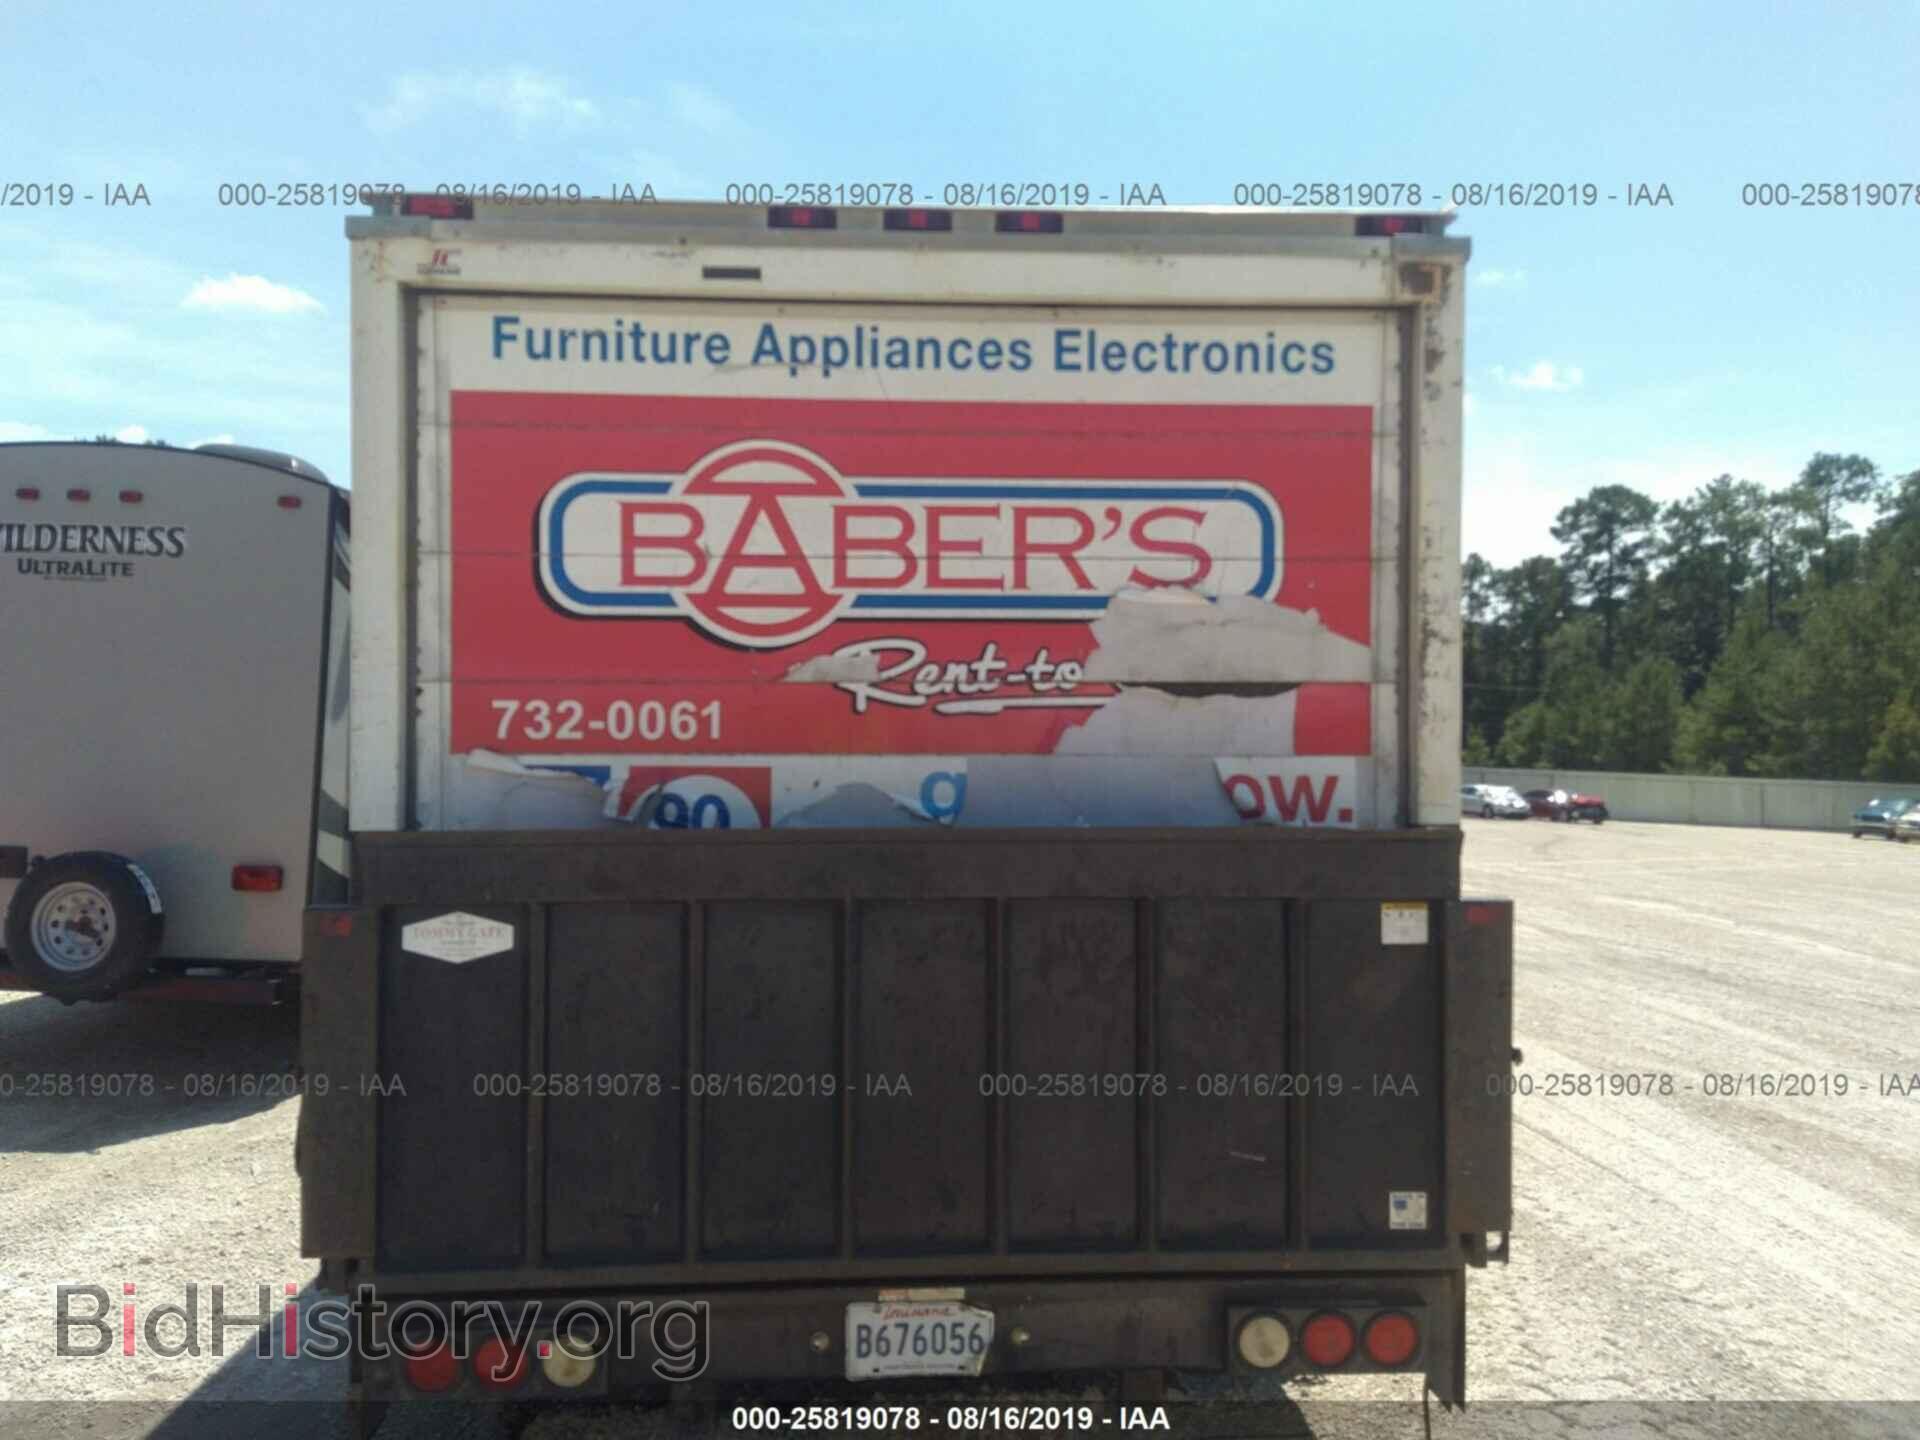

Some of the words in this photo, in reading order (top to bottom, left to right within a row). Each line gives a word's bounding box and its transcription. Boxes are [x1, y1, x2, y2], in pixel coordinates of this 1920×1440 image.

[491, 316, 731, 367] Furniture
[752, 323, 1033, 379] Appliances
[1053, 328, 1335, 375] Electronics
[619, 485, 1214, 598] BABER'S
[490, 699, 723, 741] 732-0061
[856, 1322, 985, 1358] B676056
